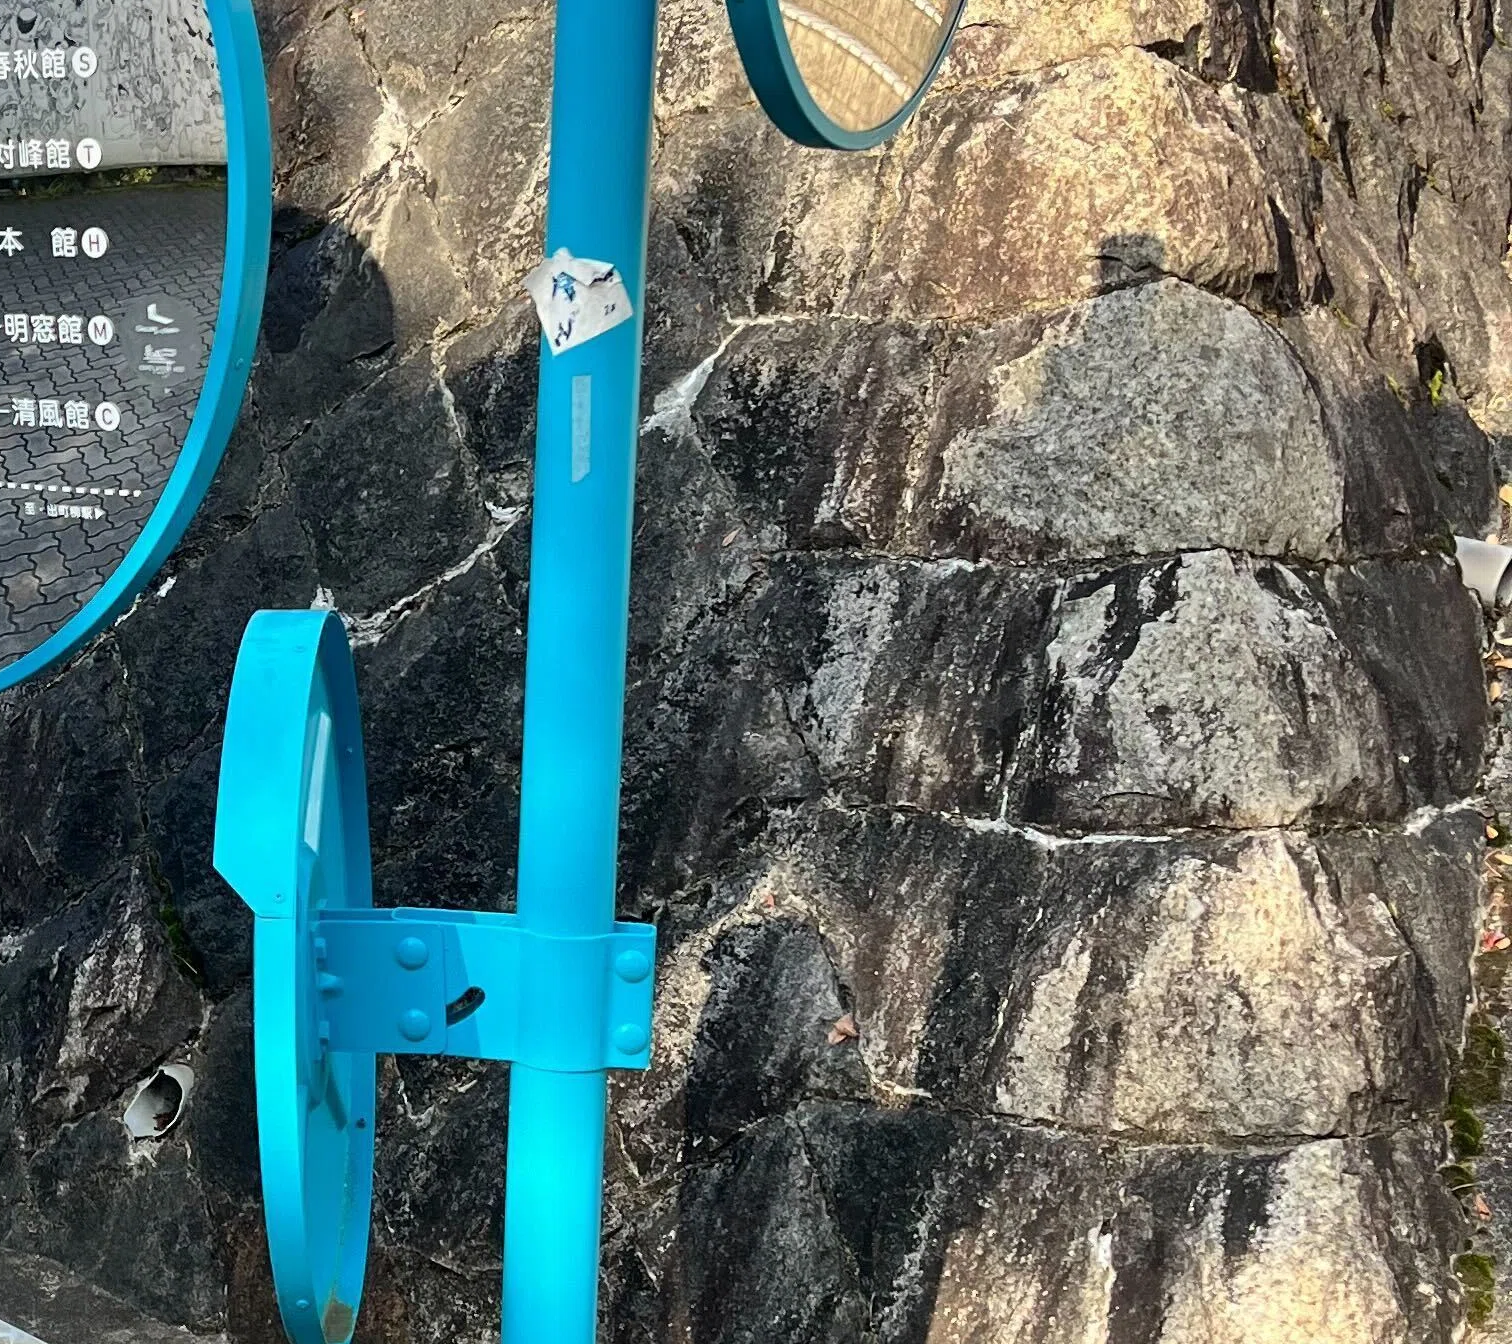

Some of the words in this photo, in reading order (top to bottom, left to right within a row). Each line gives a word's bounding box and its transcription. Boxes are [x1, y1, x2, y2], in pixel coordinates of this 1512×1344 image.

[3, 313, 84, 345] 明窓館
[11, 397, 91, 430] 清風館
